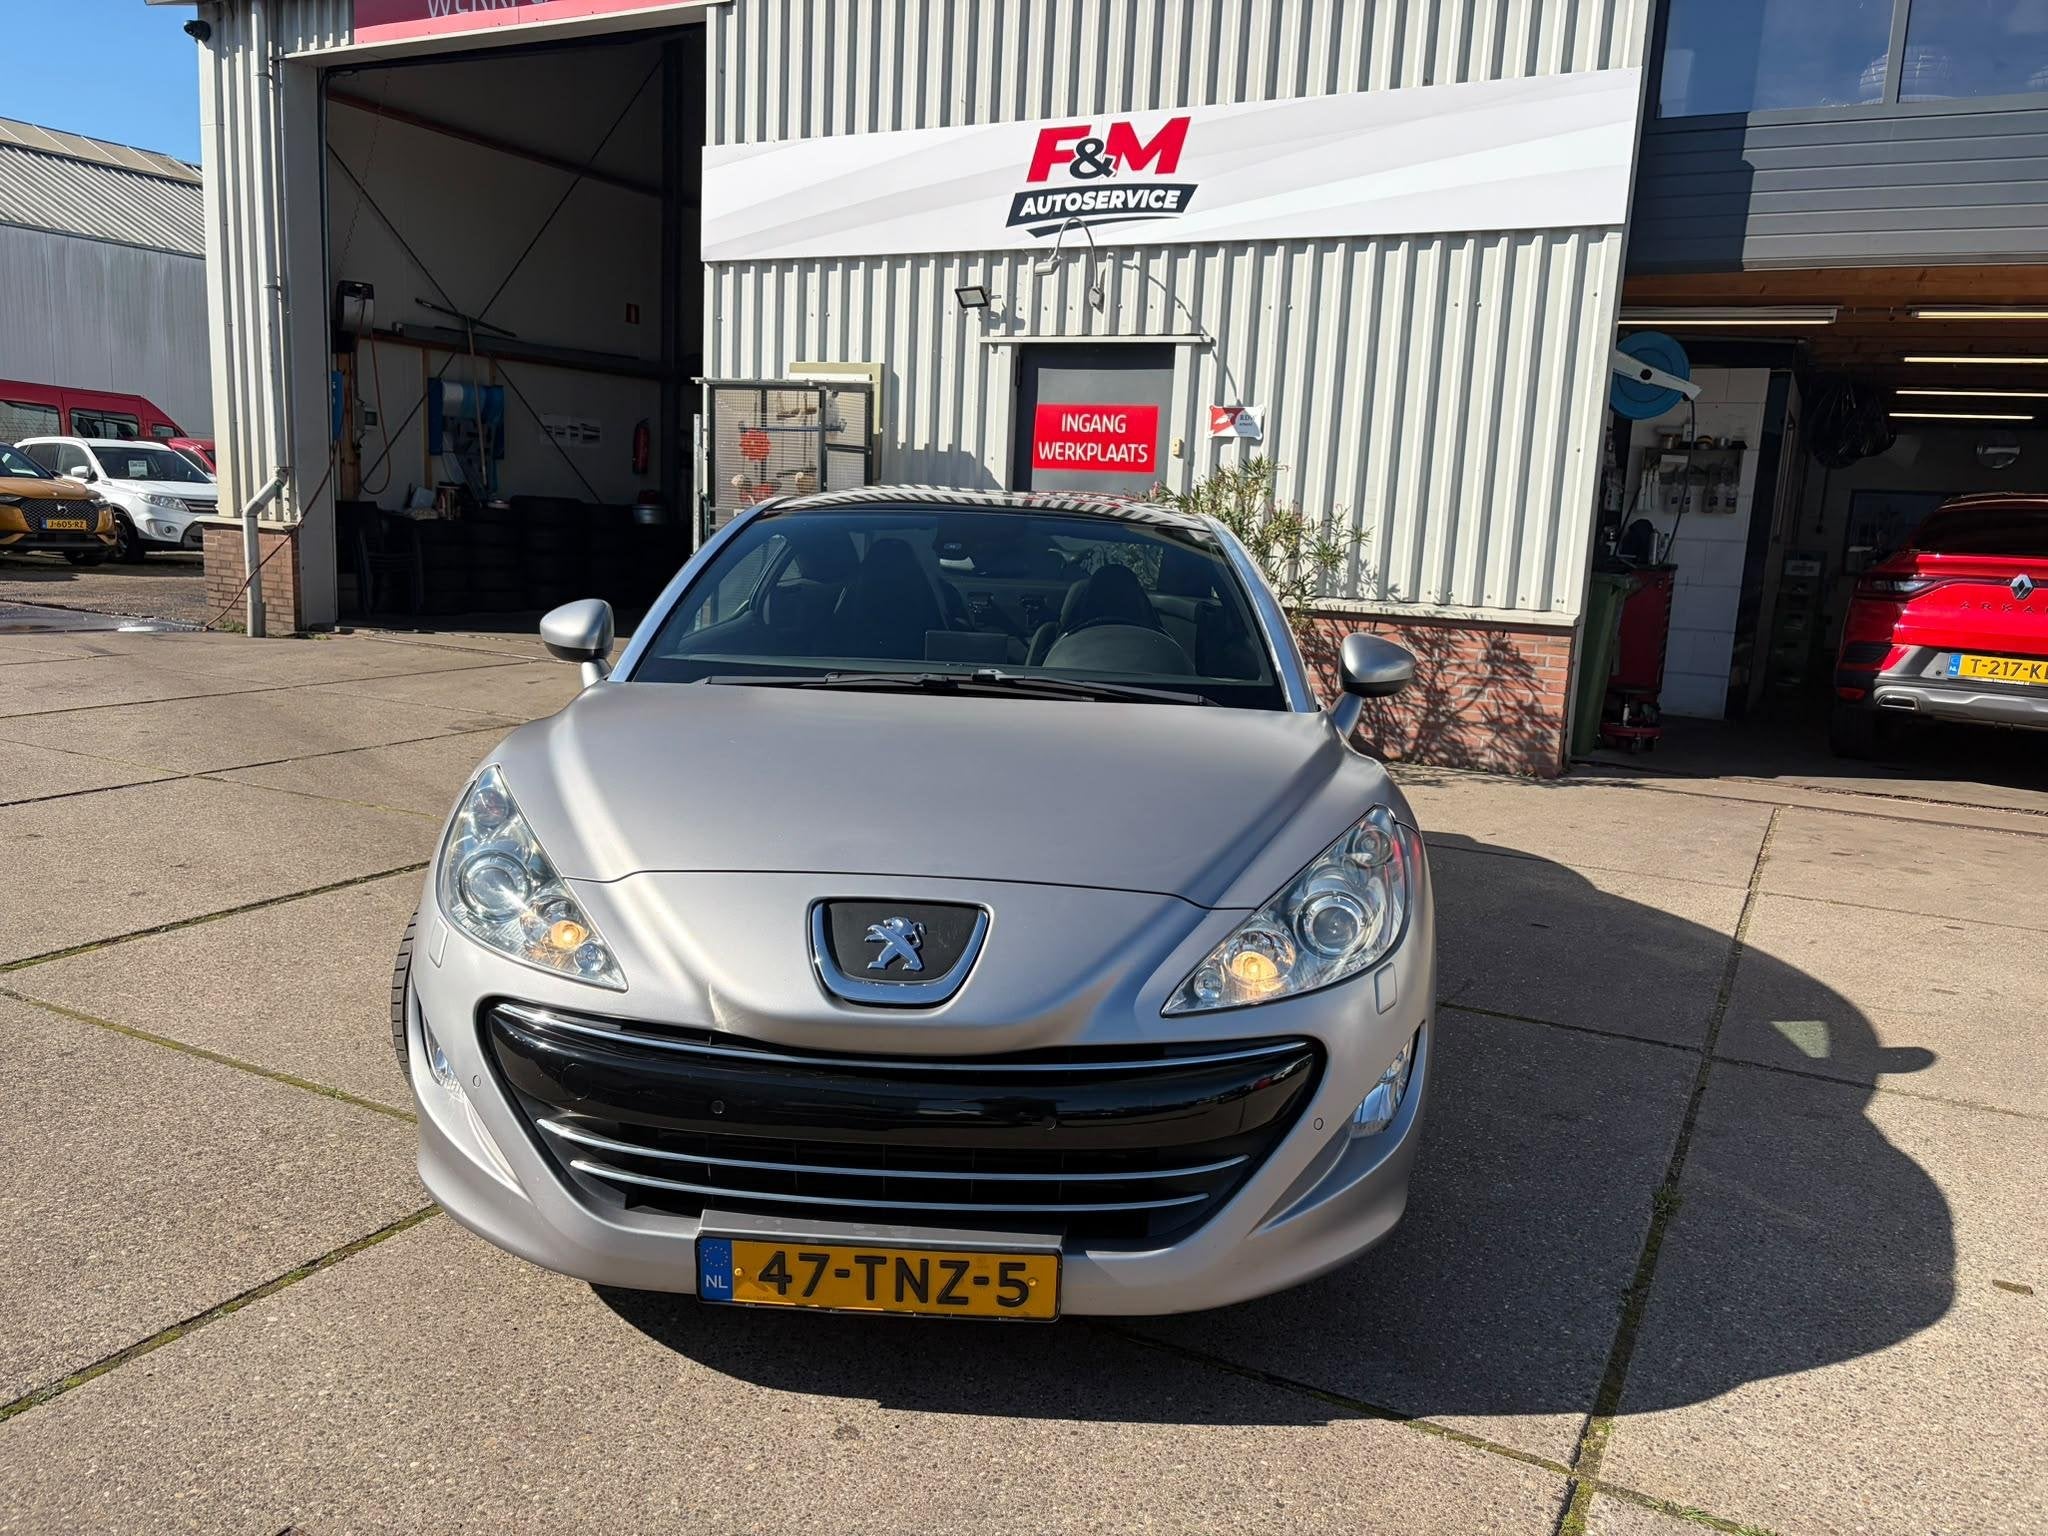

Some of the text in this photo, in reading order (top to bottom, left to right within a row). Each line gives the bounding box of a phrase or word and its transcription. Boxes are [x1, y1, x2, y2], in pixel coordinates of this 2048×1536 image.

[1026, 116, 1191, 183] F&M
[1019, 189, 1181, 216] AUTOSERVICE
[1061, 413, 1127, 433] INGANG
[1038, 442, 1148, 463] WERKPLAATS
[49, 520, 84, 528] J-605-RZ
[1960, 600, 2048, 614] ARKA
[705, 1250, 1030, 1308] NL 47-TNZ-5
